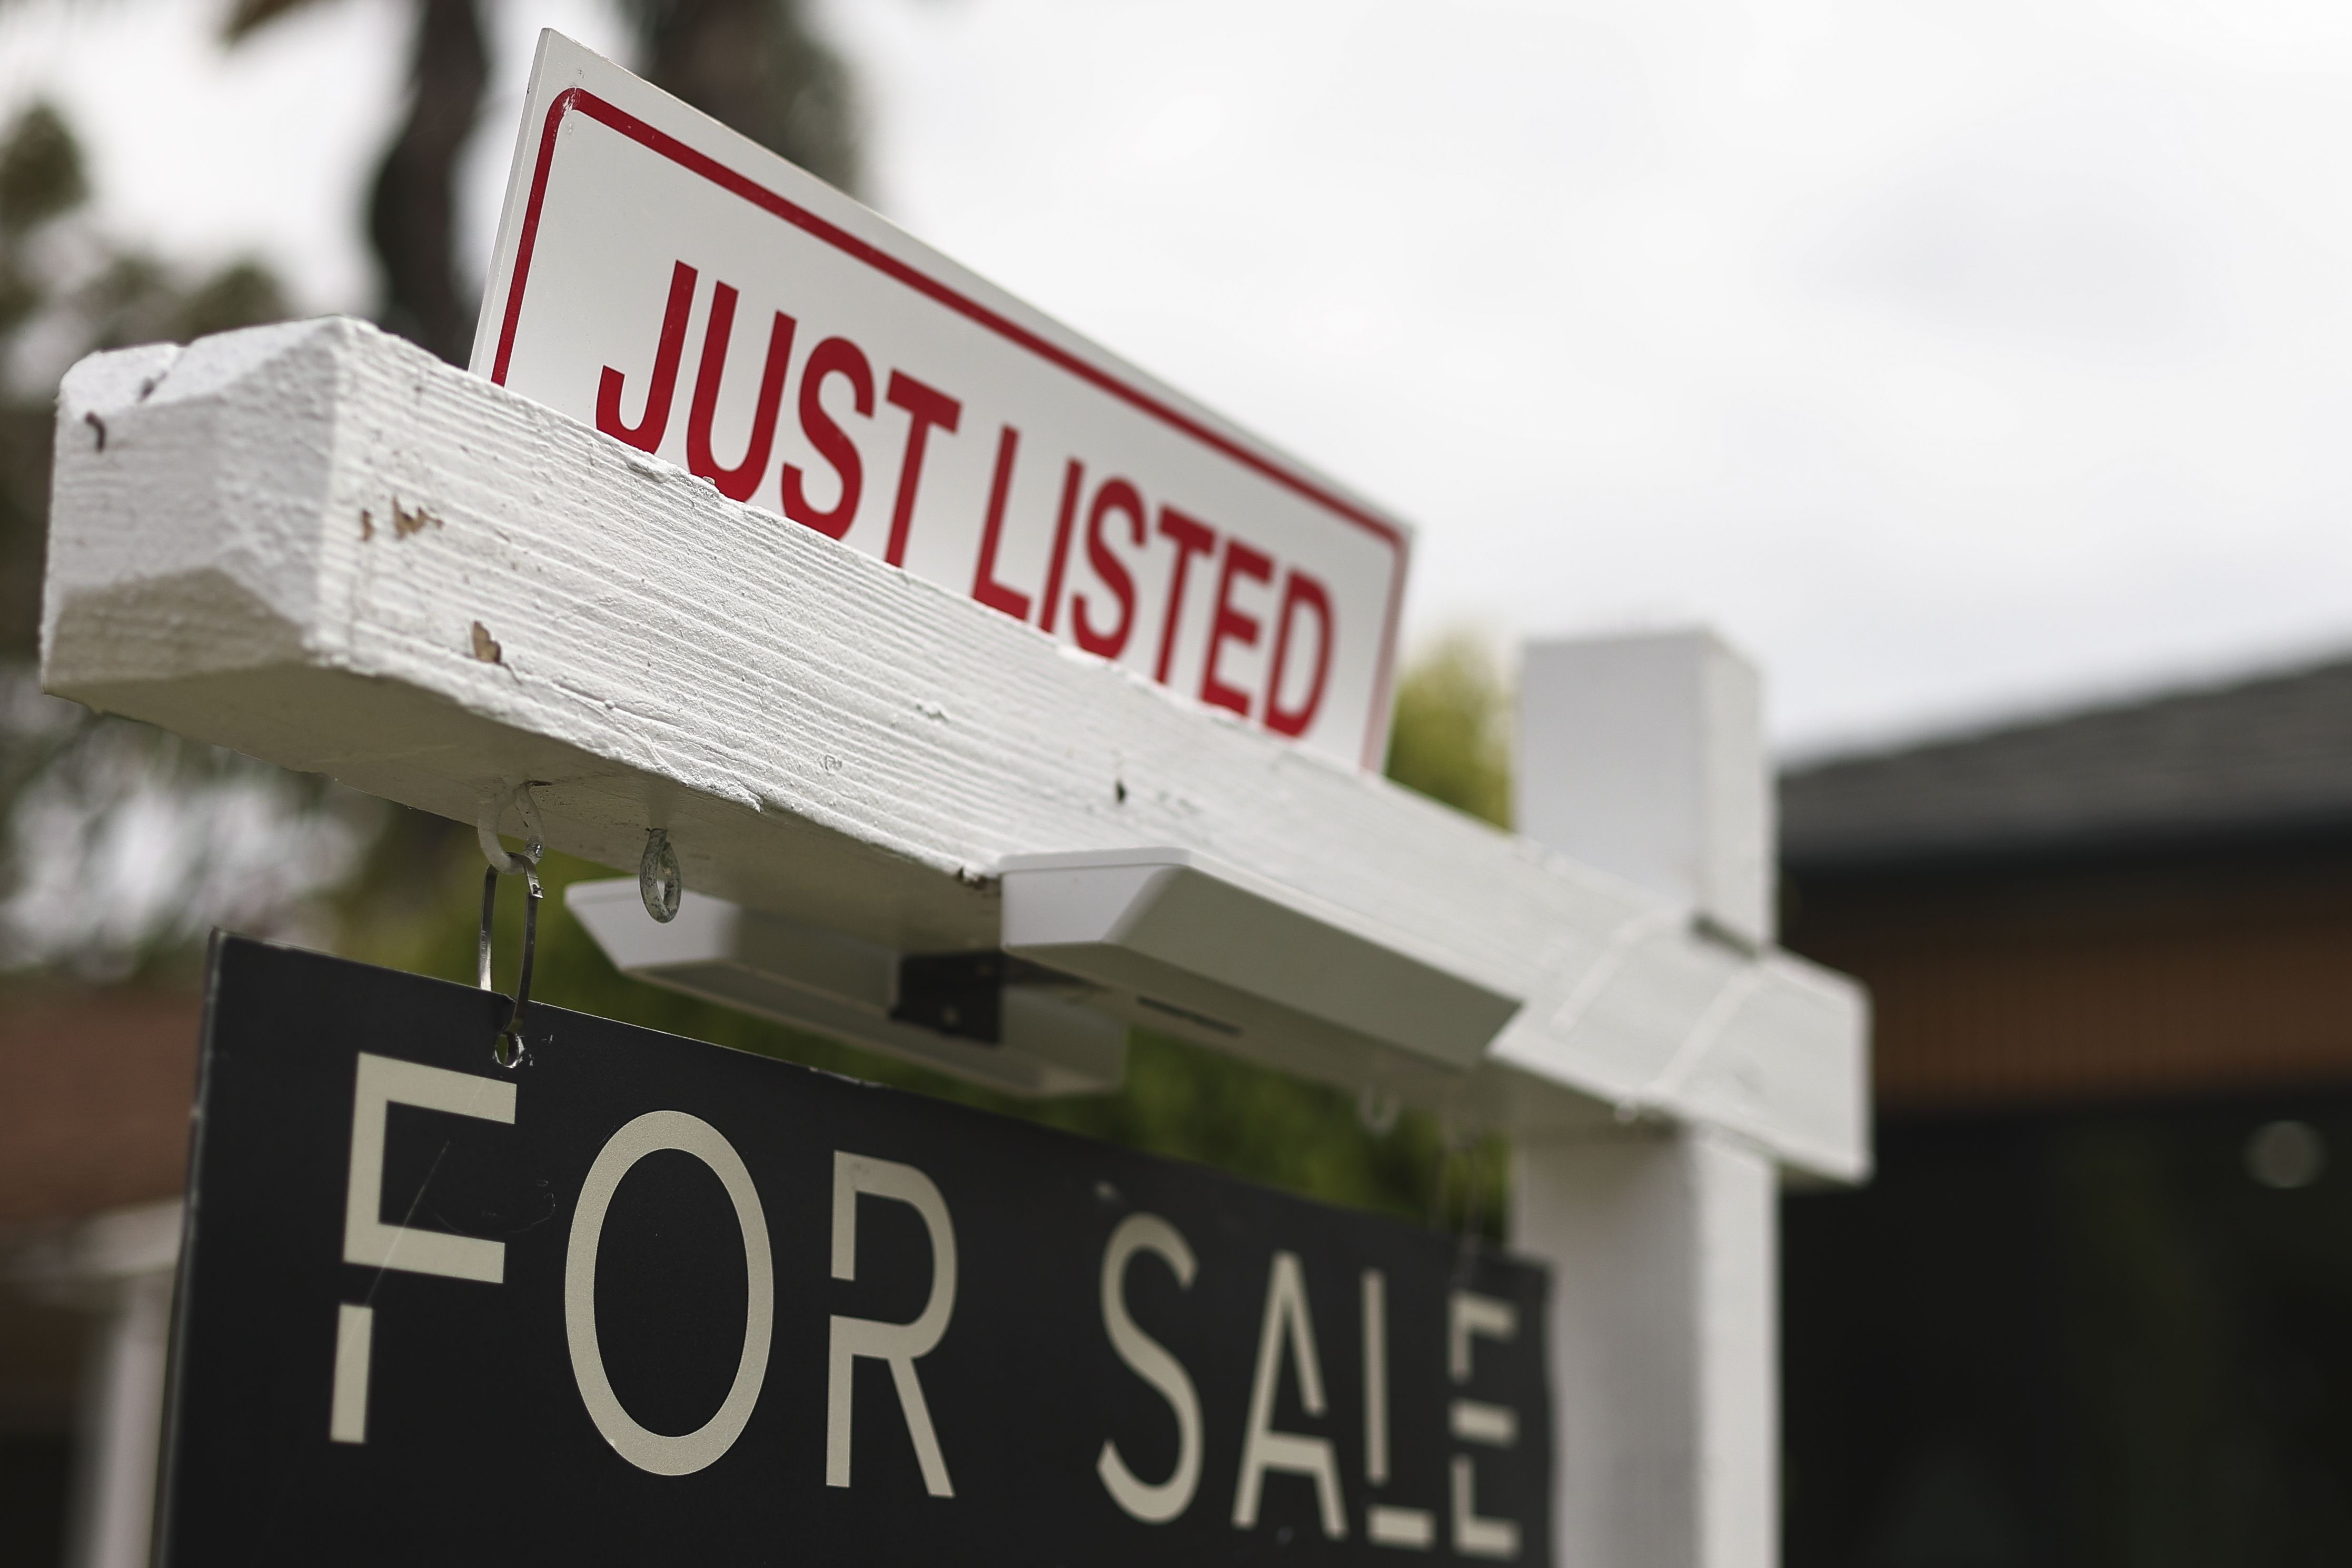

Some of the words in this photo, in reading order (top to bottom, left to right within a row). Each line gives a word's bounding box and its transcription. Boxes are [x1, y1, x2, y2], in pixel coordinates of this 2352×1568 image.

[596, 260, 963, 567] JUST
[972, 424, 1335, 739] LISTED
[330, 1051, 957, 1498] FOR
[1096, 1212, 1520, 1557] SALE
